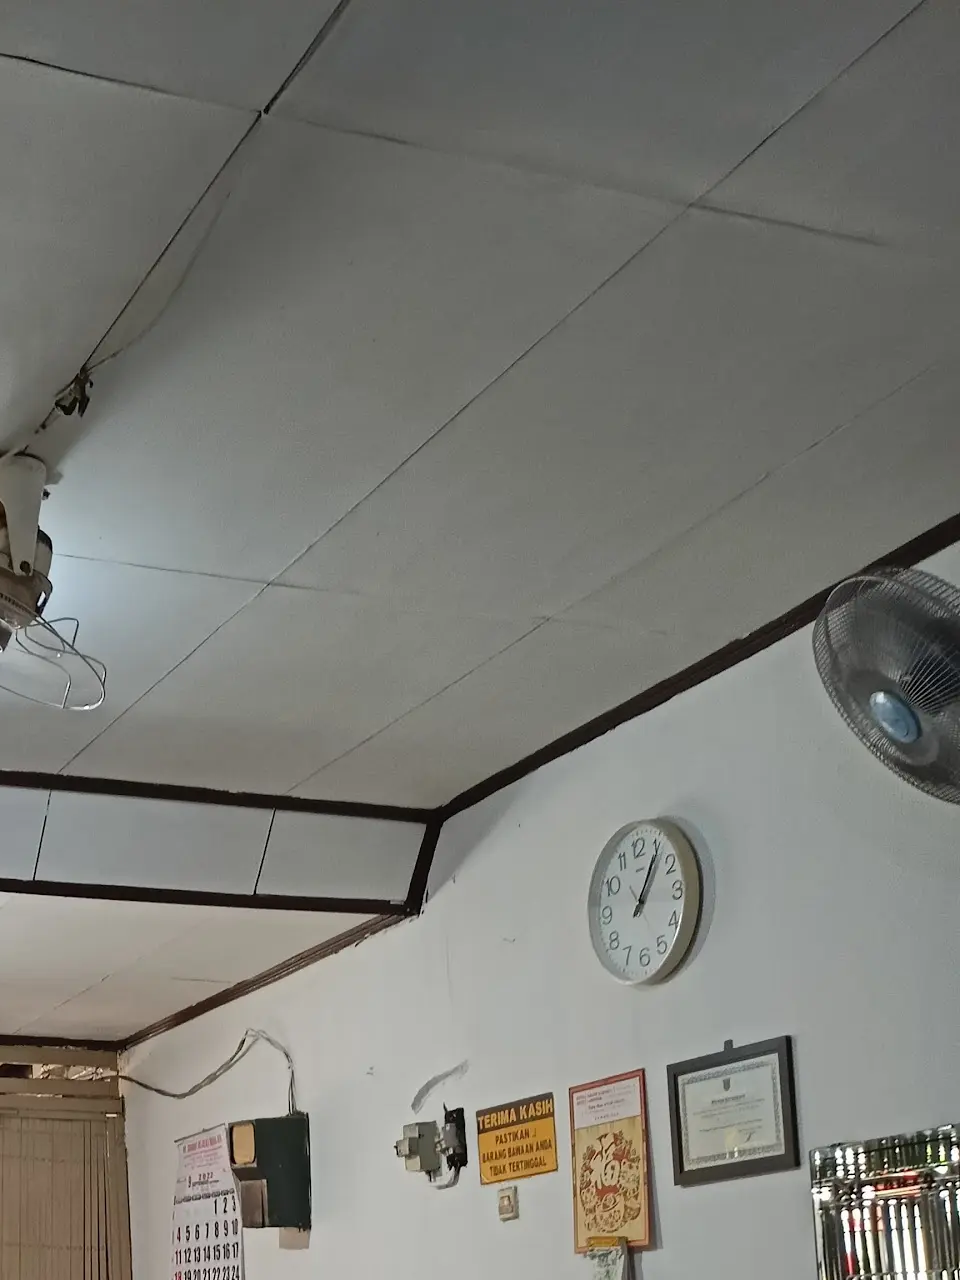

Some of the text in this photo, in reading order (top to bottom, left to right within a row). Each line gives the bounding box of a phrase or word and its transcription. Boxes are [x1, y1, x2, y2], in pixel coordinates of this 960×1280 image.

[631, 837, 646, 859] 12
[617, 851, 627, 871] 11
[665, 853, 676, 876] 2
[605, 876, 621, 897] 10
[671, 879, 683, 901] 3
[601, 905, 613, 926] 9
[668, 910, 680, 932] 4
[609, 931, 620, 951] 8
[656, 935, 668, 955] 5
[622, 945, 632, 966] 7
[639, 947, 651, 967] 6
[478, 1107, 517, 1130] TERIMA
[520, 1098, 553, 1120] KASIH
[495, 1128, 530, 1146] PASTIKAN
[482, 1138, 552, 1164] BARANG BAWAAN ANDA
[197, 1171, 214, 1182] 2022
[489, 1156, 547, 1177] TIDAK TERTINGGAL
[214, 1198, 218, 1215] 1
[223, 1197, 228, 1214] 2
[231, 1195, 236, 1212] 3
[176, 1218, 239, 1242] 4 5 6 7 8 9 10
[175, 1241, 239, 1265] 11 12 13 14 15 16 17
